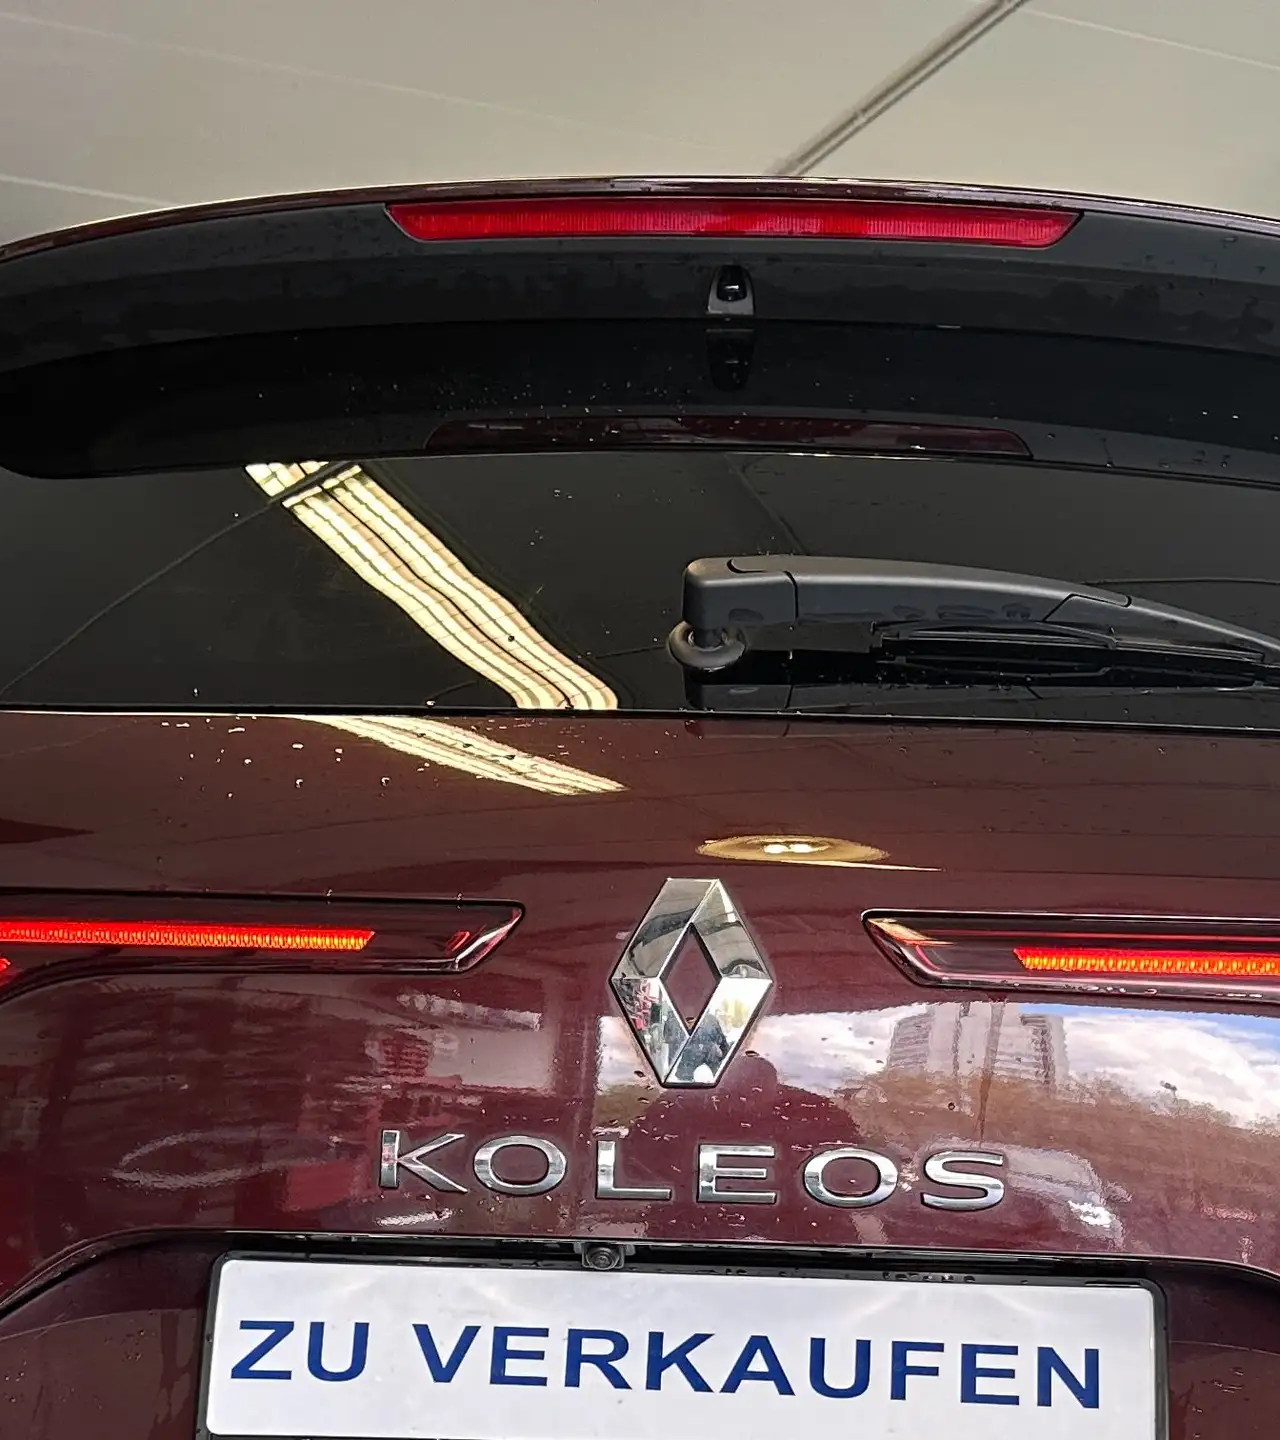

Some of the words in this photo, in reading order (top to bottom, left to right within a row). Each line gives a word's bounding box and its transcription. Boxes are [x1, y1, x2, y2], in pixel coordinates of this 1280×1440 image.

[378, 1129, 1006, 1211] KOLEOS
[231, 1319, 370, 1383] ZU
[413, 1323, 1102, 1410] VERKAUFEN
